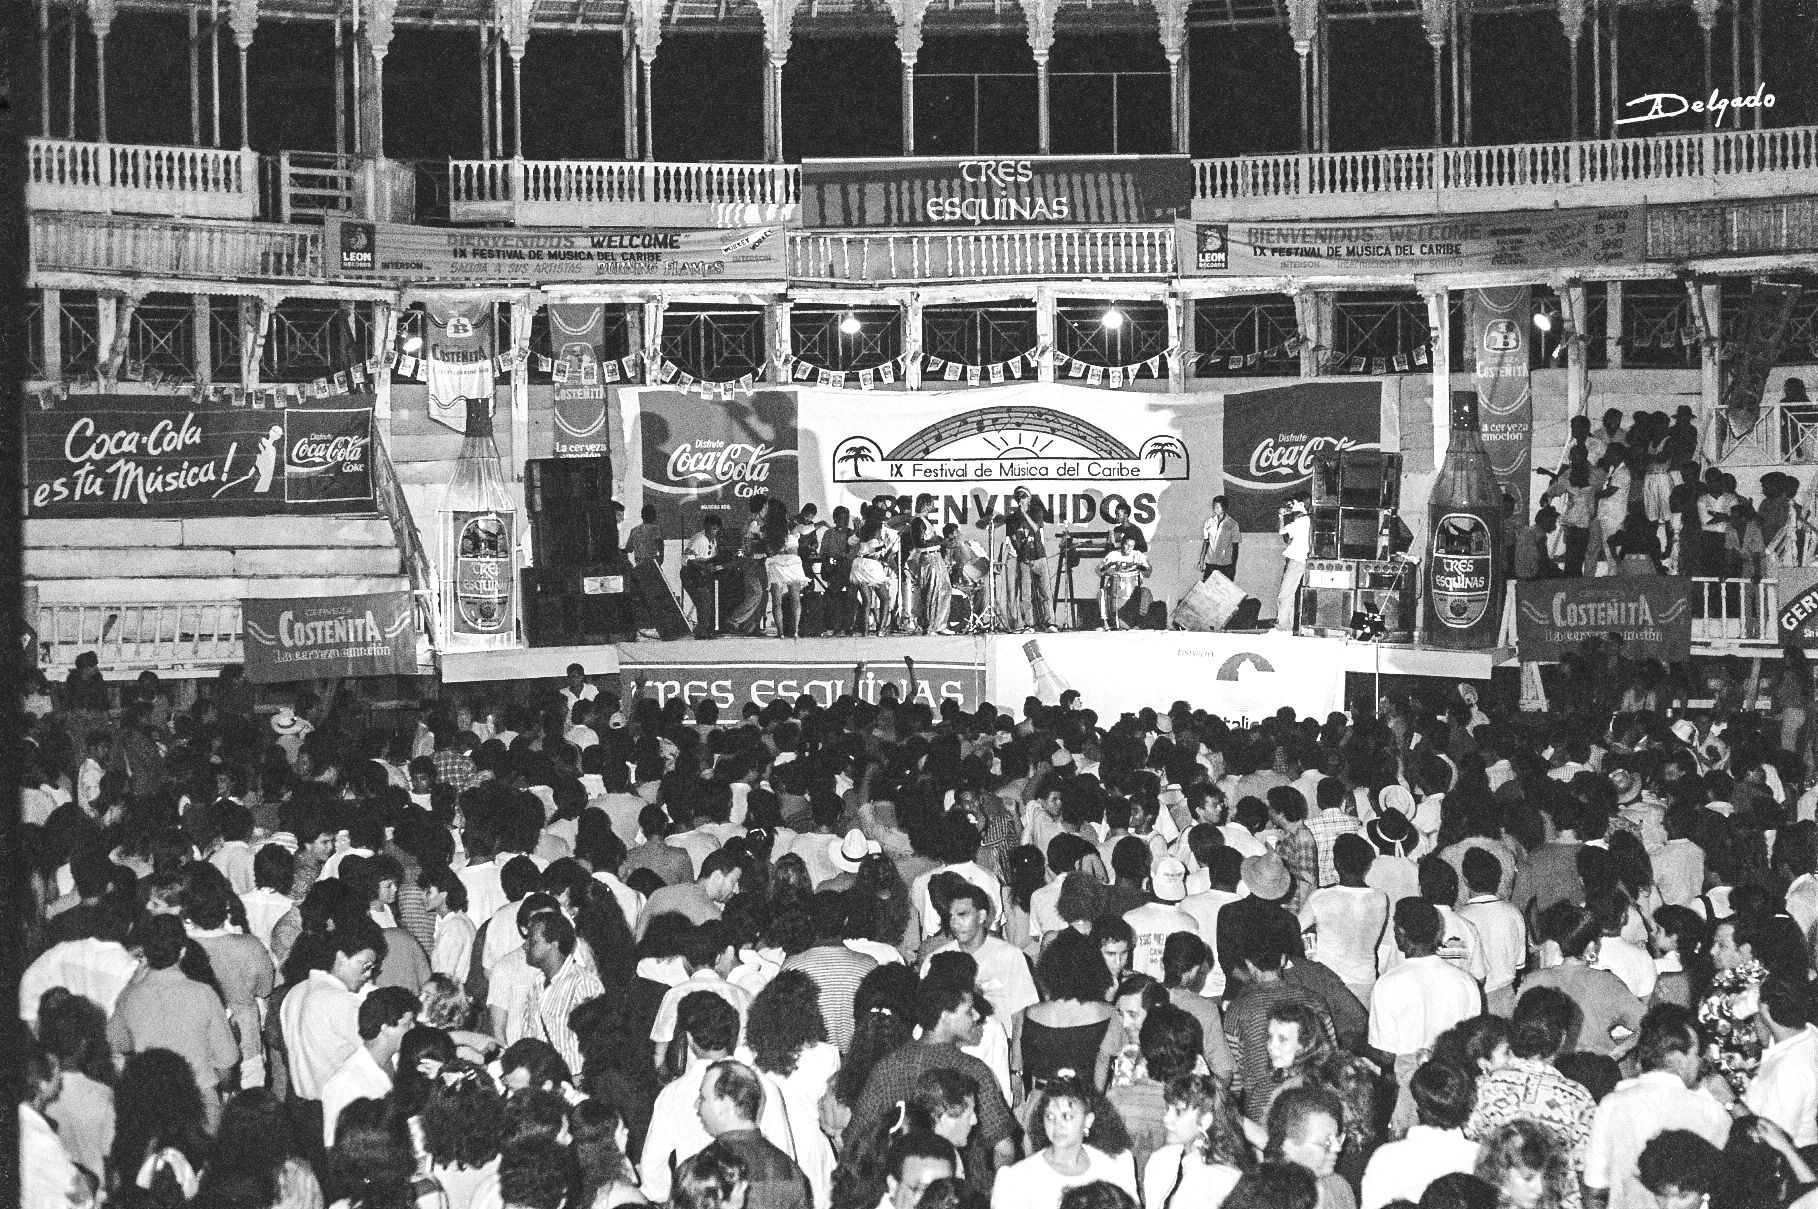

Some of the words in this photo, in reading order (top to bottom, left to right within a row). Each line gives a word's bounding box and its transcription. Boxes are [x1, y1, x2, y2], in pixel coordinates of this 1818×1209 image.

[959, 161, 1032, 187] TRES
[926, 191, 1068, 225] ESQUINAS
[590, 233, 681, 249] WELCOME
[1249, 227, 1375, 245] BIENVENIDOS
[1389, 223, 1483, 242] WELCOME
[343, 252, 371, 262] LEON
[453, 248, 467, 258] IX
[473, 249, 525, 260] FESTIVAL
[528, 250, 544, 260] DE
[548, 250, 594, 261] MUSICA
[597, 251, 616, 261] DEL
[621, 251, 662, 262] CARIBE
[1199, 253, 1225, 262] LEON
[1253, 246, 1266, 257] IX
[1271, 246, 1322, 258] FESTIVAL
[1326, 246, 1341, 257] DE
[1346, 245, 1392, 257] MUSICA
[1395, 245, 1415, 256] DEL
[1420, 243, 1462, 255] CARIBE
[381, 261, 423, 270] INTERSON
[1490, 424, 1528, 433] cerveza
[65, 412, 202, 462] Coca-Cola
[695, 439, 725, 449] Disfrute
[1278, 433, 1308, 443] Disfrute
[292, 435, 363, 463] Coca-Cola
[556, 443, 567, 453] La
[569, 444, 607, 452] cerveza
[342, 461, 365, 473] Coke
[666, 443, 774, 482] Coca-Cola
[890, 463, 904, 477] IX
[912, 463, 968, 477] Festival
[974, 463, 992, 477] de
[999, 462, 1049, 478] Música
[1056, 462, 1080, 477] del
[1087, 461, 1141, 477] Caribe
[34, 477, 69, 506] es
[74, 461, 104, 501] tu
[734, 481, 769, 498] Coke
[1443, 559, 1474, 574] TRES
[1436, 574, 1485, 591] ESQUINAS
[1552, 591, 1655, 627] COSTEÑITA
[279, 610, 382, 648] COSTEÑITA
